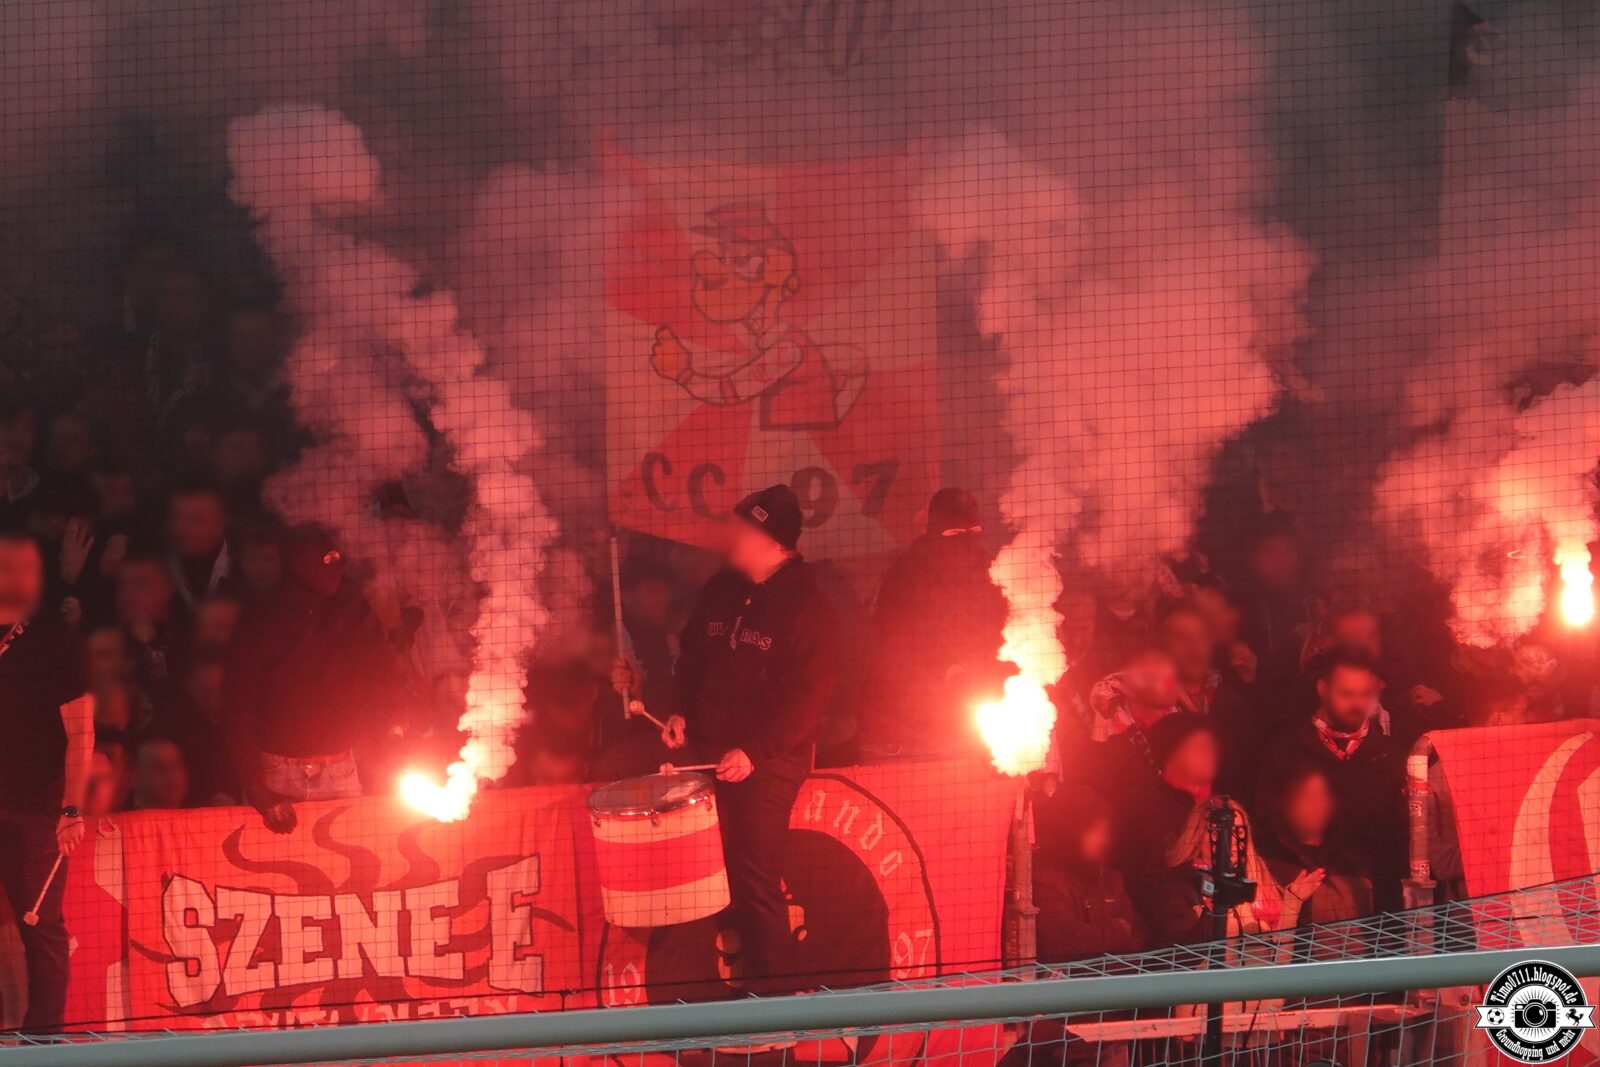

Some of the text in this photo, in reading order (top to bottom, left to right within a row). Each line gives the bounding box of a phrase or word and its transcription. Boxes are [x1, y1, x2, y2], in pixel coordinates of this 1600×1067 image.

[790, 458, 899, 529] 97
[161, 853, 545, 1008] SZENE E
[602, 928, 935, 1008] 19 97
